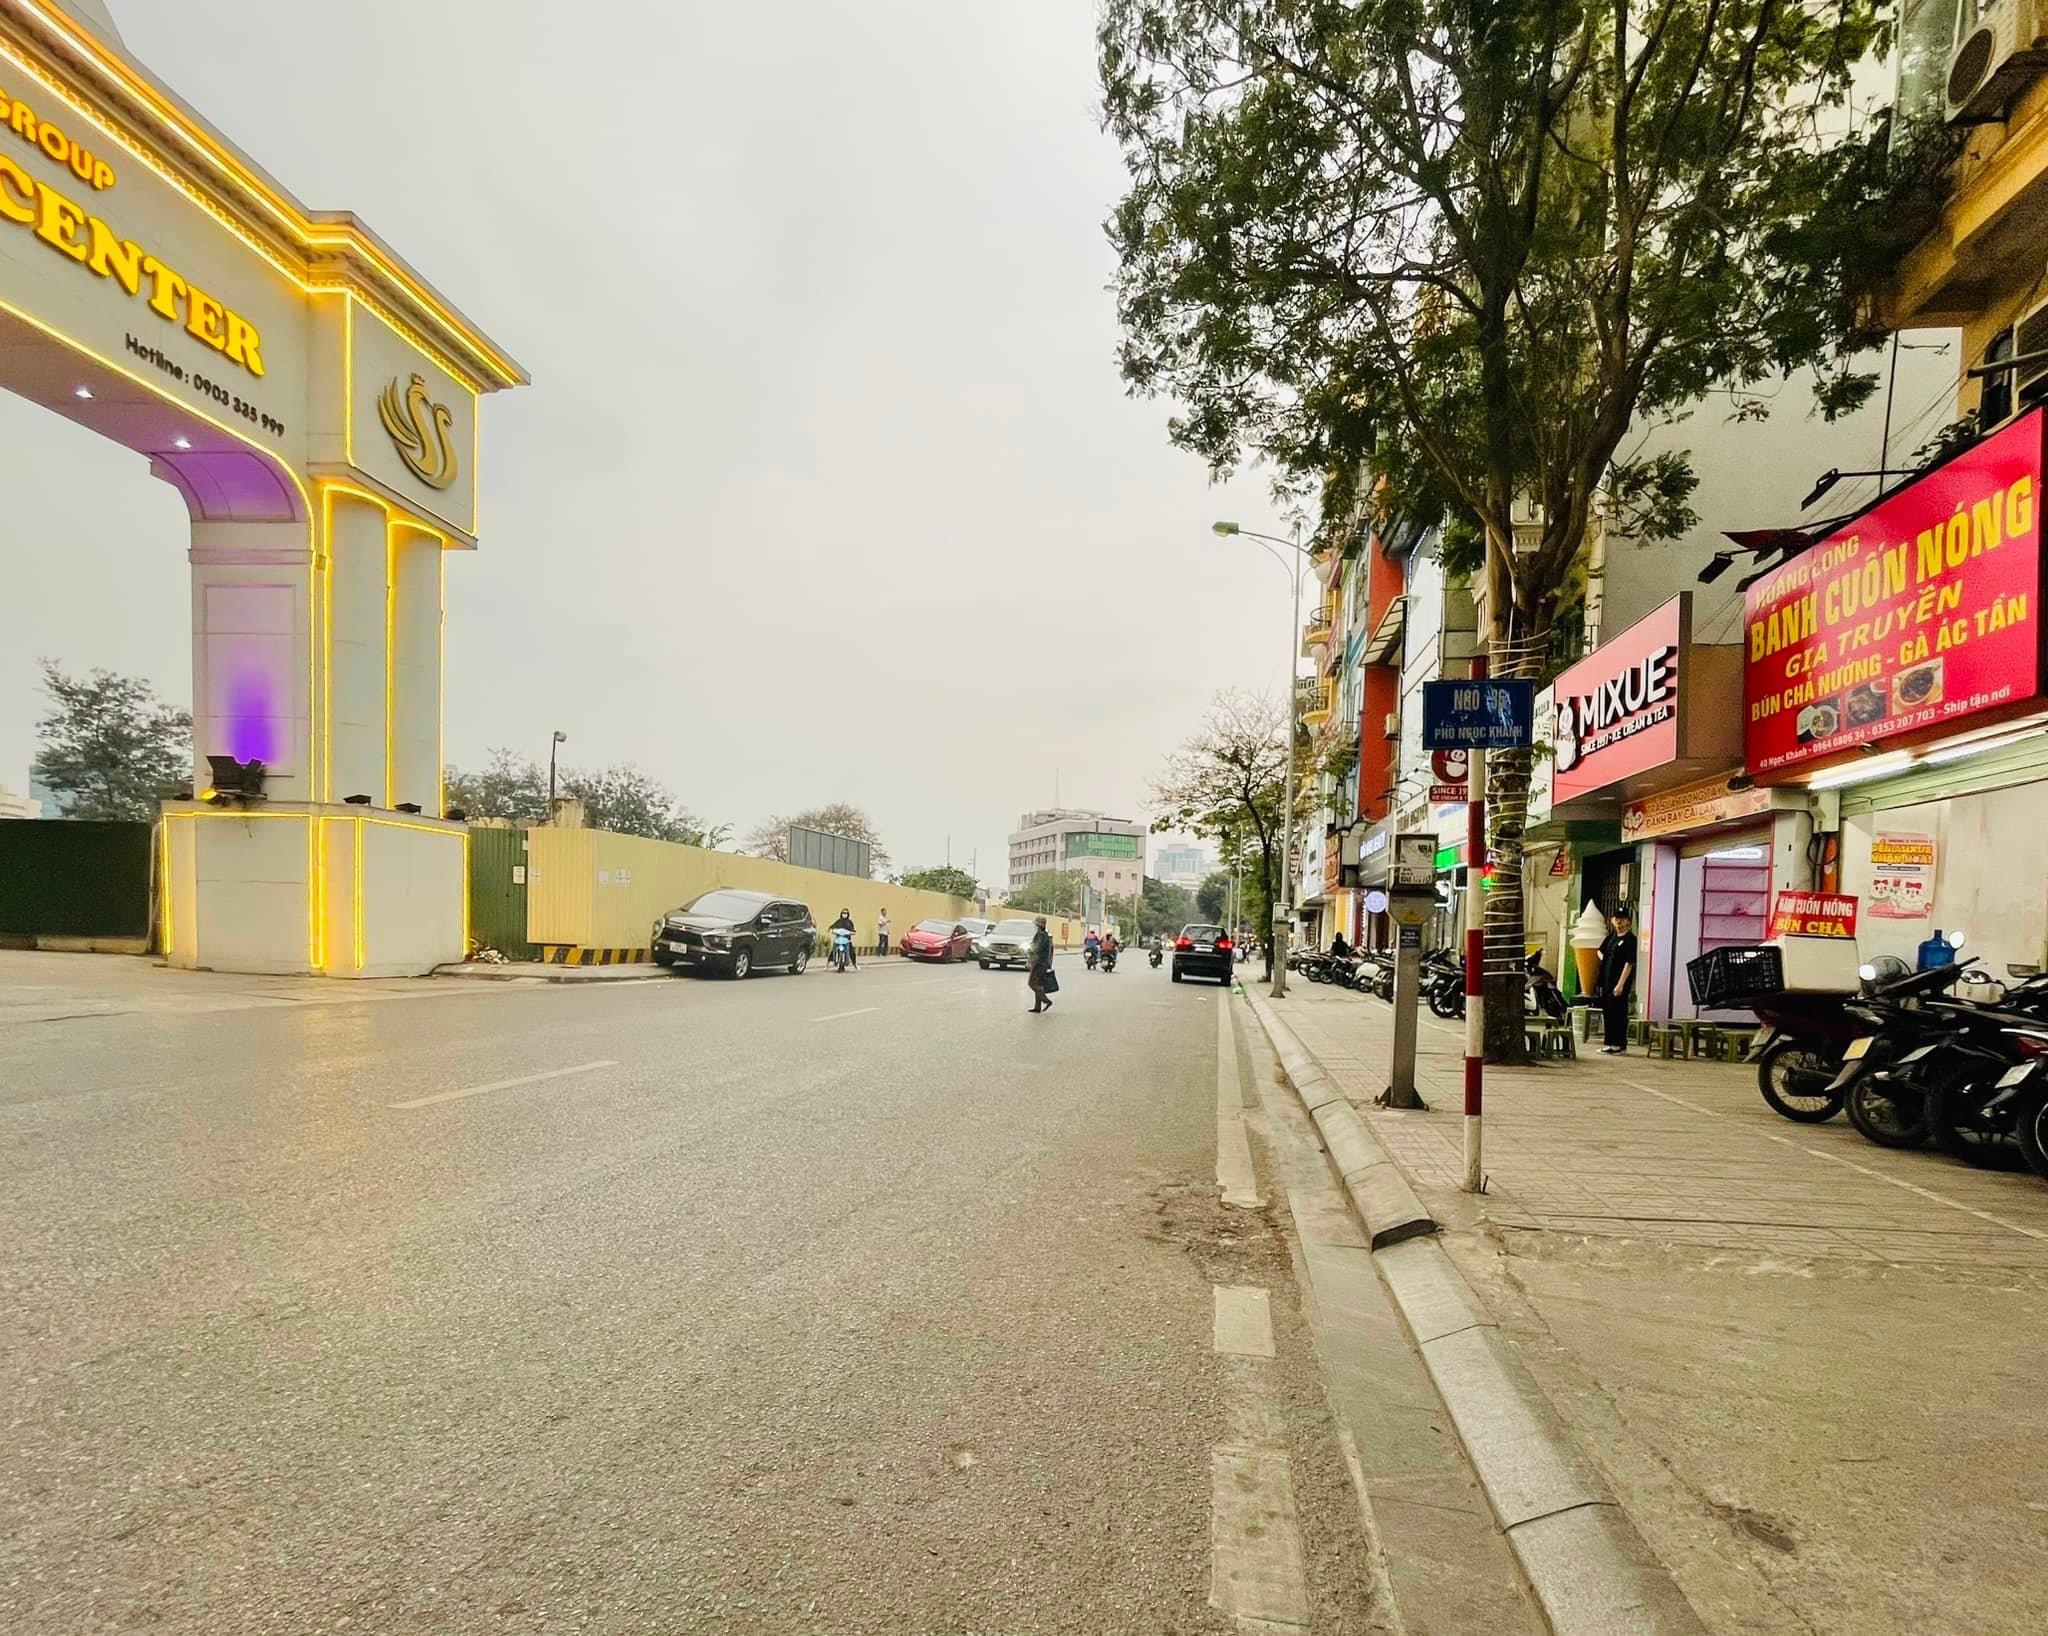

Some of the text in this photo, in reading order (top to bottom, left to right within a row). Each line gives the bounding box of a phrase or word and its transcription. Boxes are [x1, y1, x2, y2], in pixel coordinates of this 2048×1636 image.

[0, 153, 265, 376] CENTER
[193, 374, 229, 406] 0903
[261, 414, 285, 437] 999
[1751, 475, 2033, 663] BÁNH CUỐN NÓNG
[1751, 693, 1780, 722] BÚN
[1784, 674, 1814, 709] CHẢ
[1818, 654, 1882, 698] NƯỚNG
[1899, 631, 1929, 666] GÀ
[1936, 617, 1968, 652] ÁC
[1785, 579, 1963, 677] GIA TRUYỀN
[1579, 646, 1667, 737] MIXUE
[1654, 706, 1669, 722] TEA
[1785, 747, 1808, 760] Khánh
[1896, 715, 1914, 729] 207
[1916, 709, 1935, 723] 703
[1943, 700, 1968, 715] Ship
[1969, 692, 1989, 709] tận
[1991, 685, 2011, 701] nơi
[1432, 786, 1467, 795] SINCE 19
[1822, 898, 1853, 917] NÓNG
